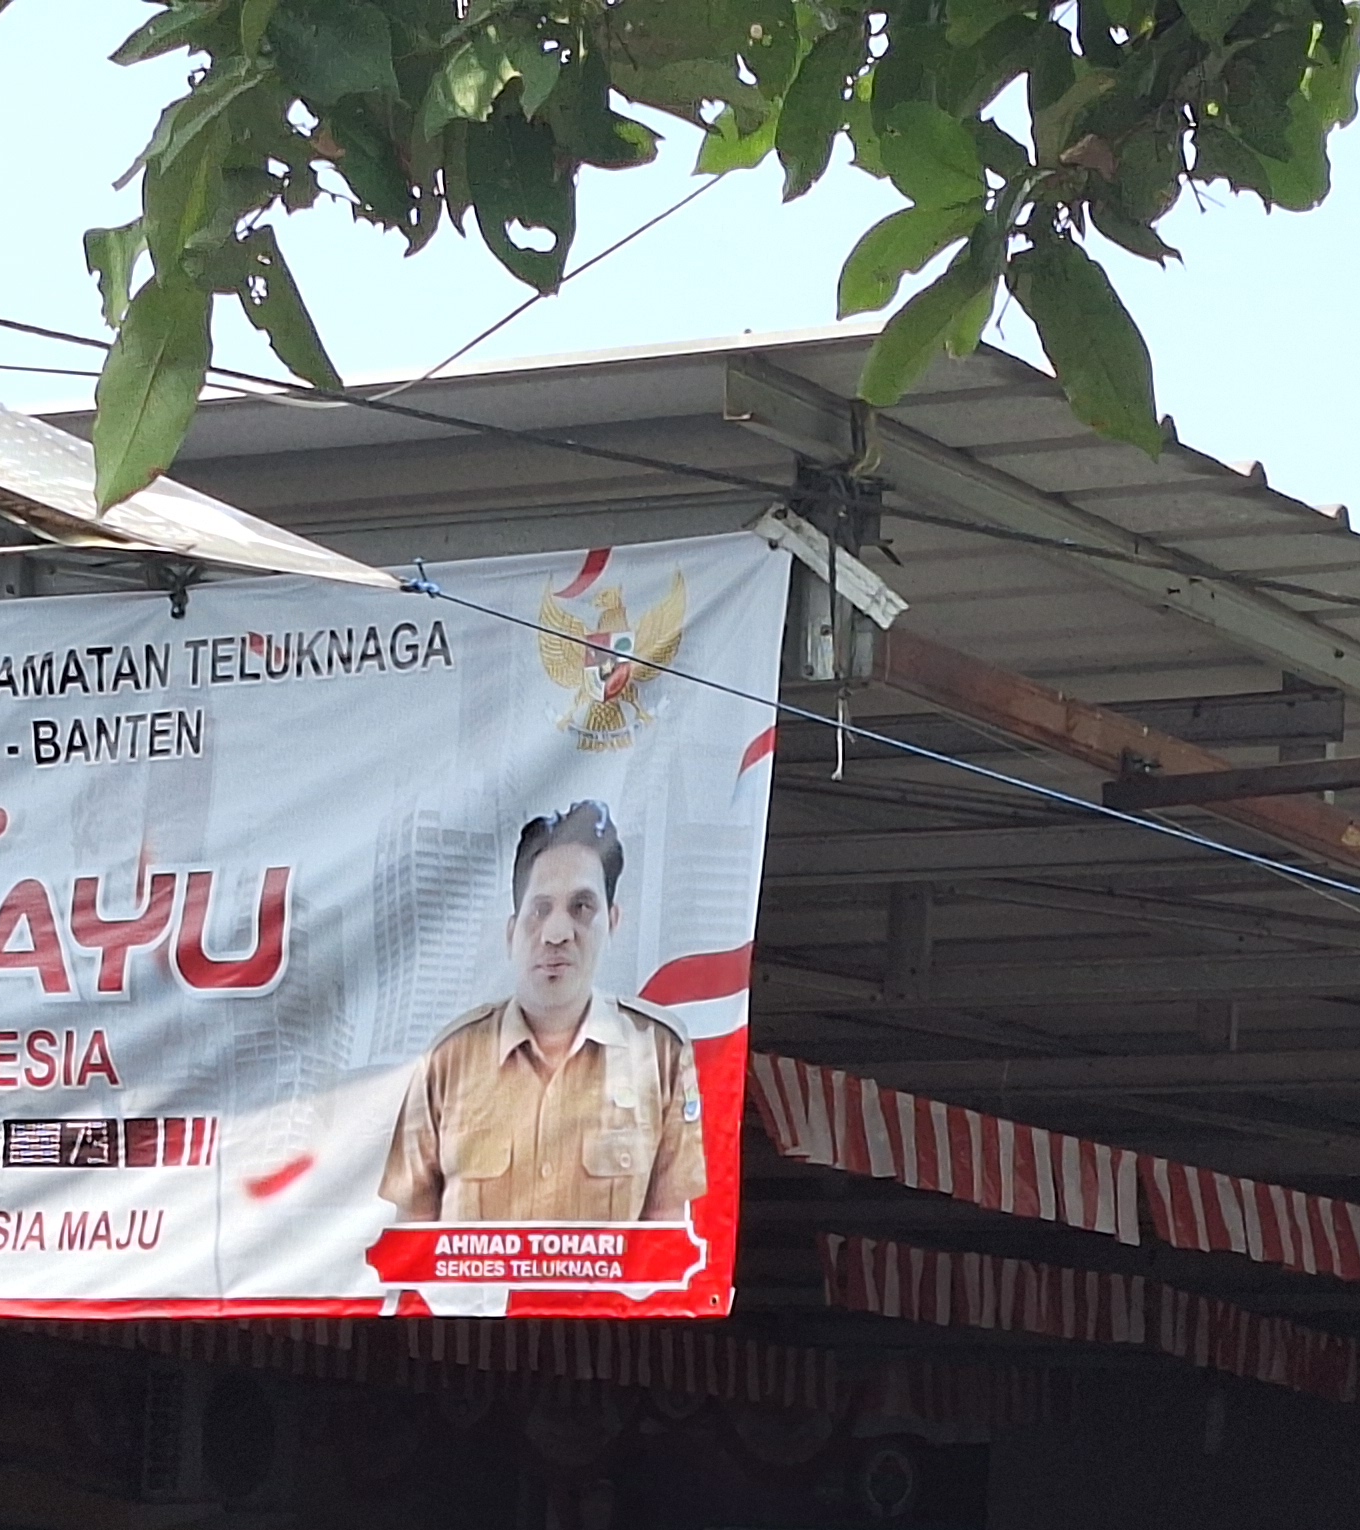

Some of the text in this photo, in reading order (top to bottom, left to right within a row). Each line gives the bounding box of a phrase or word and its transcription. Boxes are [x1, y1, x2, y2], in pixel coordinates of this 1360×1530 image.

[185, 620, 454, 685] TELUKNAGA
[32, 709, 204, 767] BANTEN
[58, 1206, 165, 1251] MAJU
[434, 1233, 625, 1256] AHMAD TOHARI
[434, 1259, 623, 1279] SEKDES TELUKNAGA
